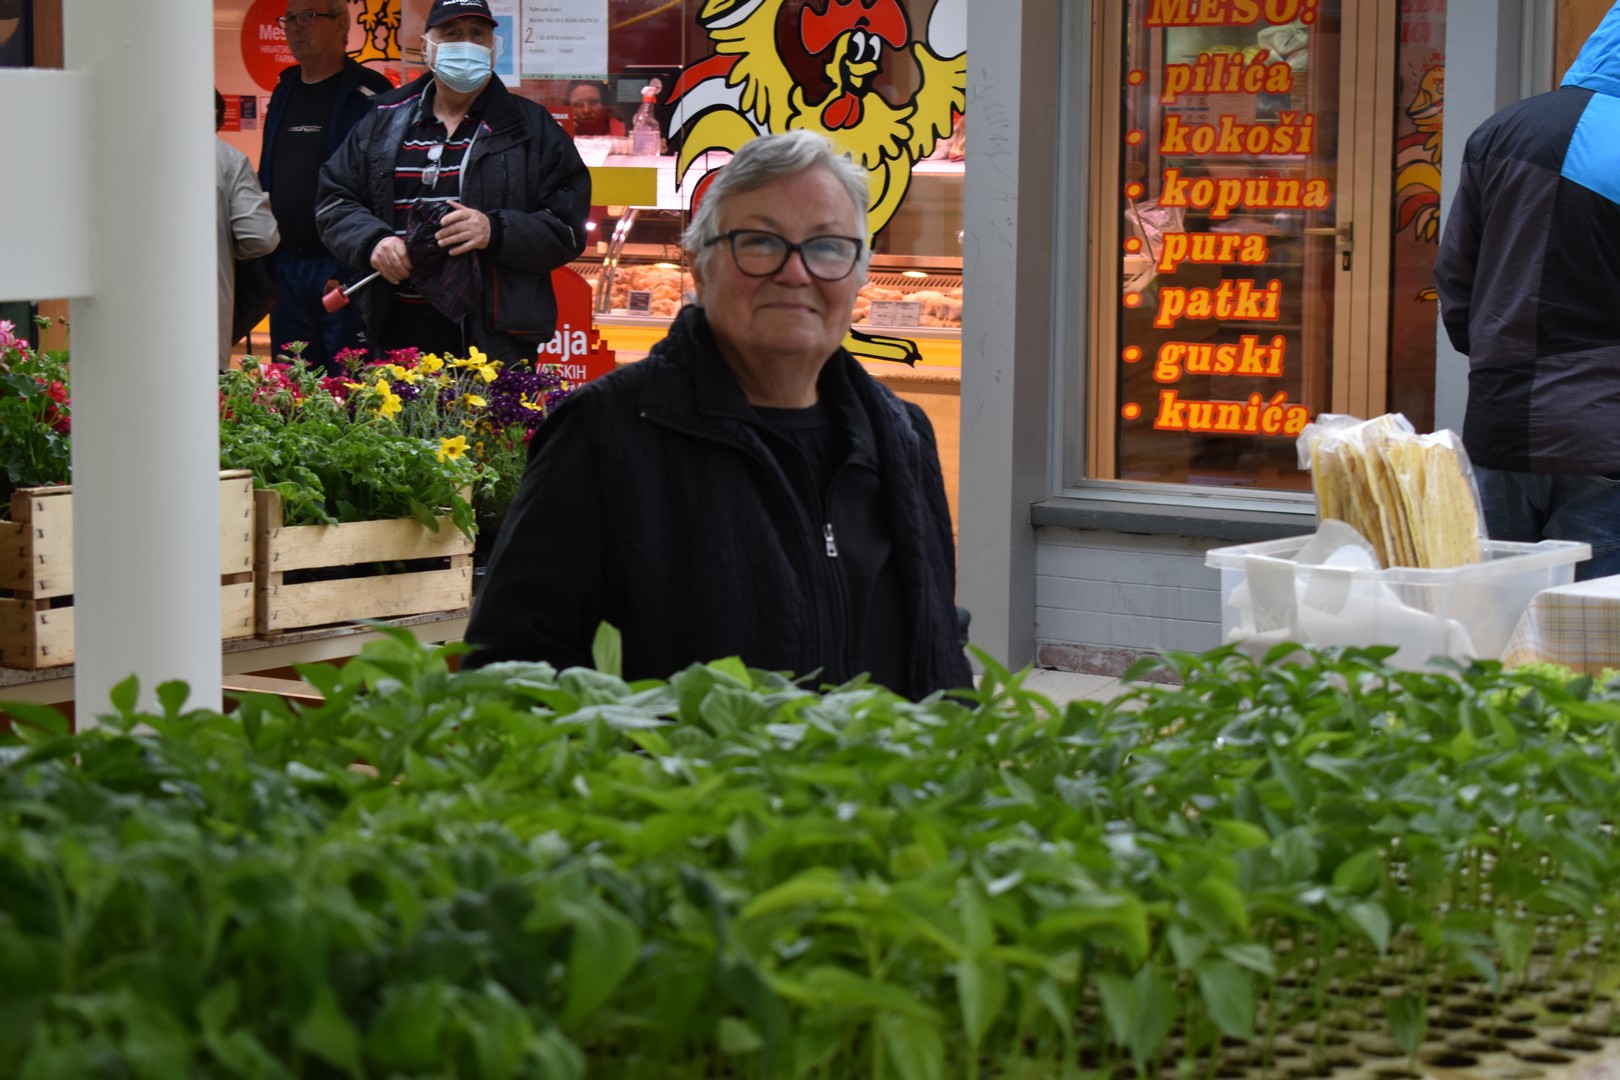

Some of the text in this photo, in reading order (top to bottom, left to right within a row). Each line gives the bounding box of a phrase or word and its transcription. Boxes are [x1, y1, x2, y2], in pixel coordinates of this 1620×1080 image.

[259, 24, 287, 41] Mes
[524, 27, 535, 43] 2
[1161, 50, 1293, 104] pilića
[1160, 112, 1315, 155] kokoši
[1160, 169, 1330, 219] kopuna
[1157, 234, 1267, 273] pura
[1155, 280, 1281, 328] patki
[536, 323, 588, 362] aja
[1155, 336, 1286, 382] guski
[1156, 390, 1311, 436] kunića
